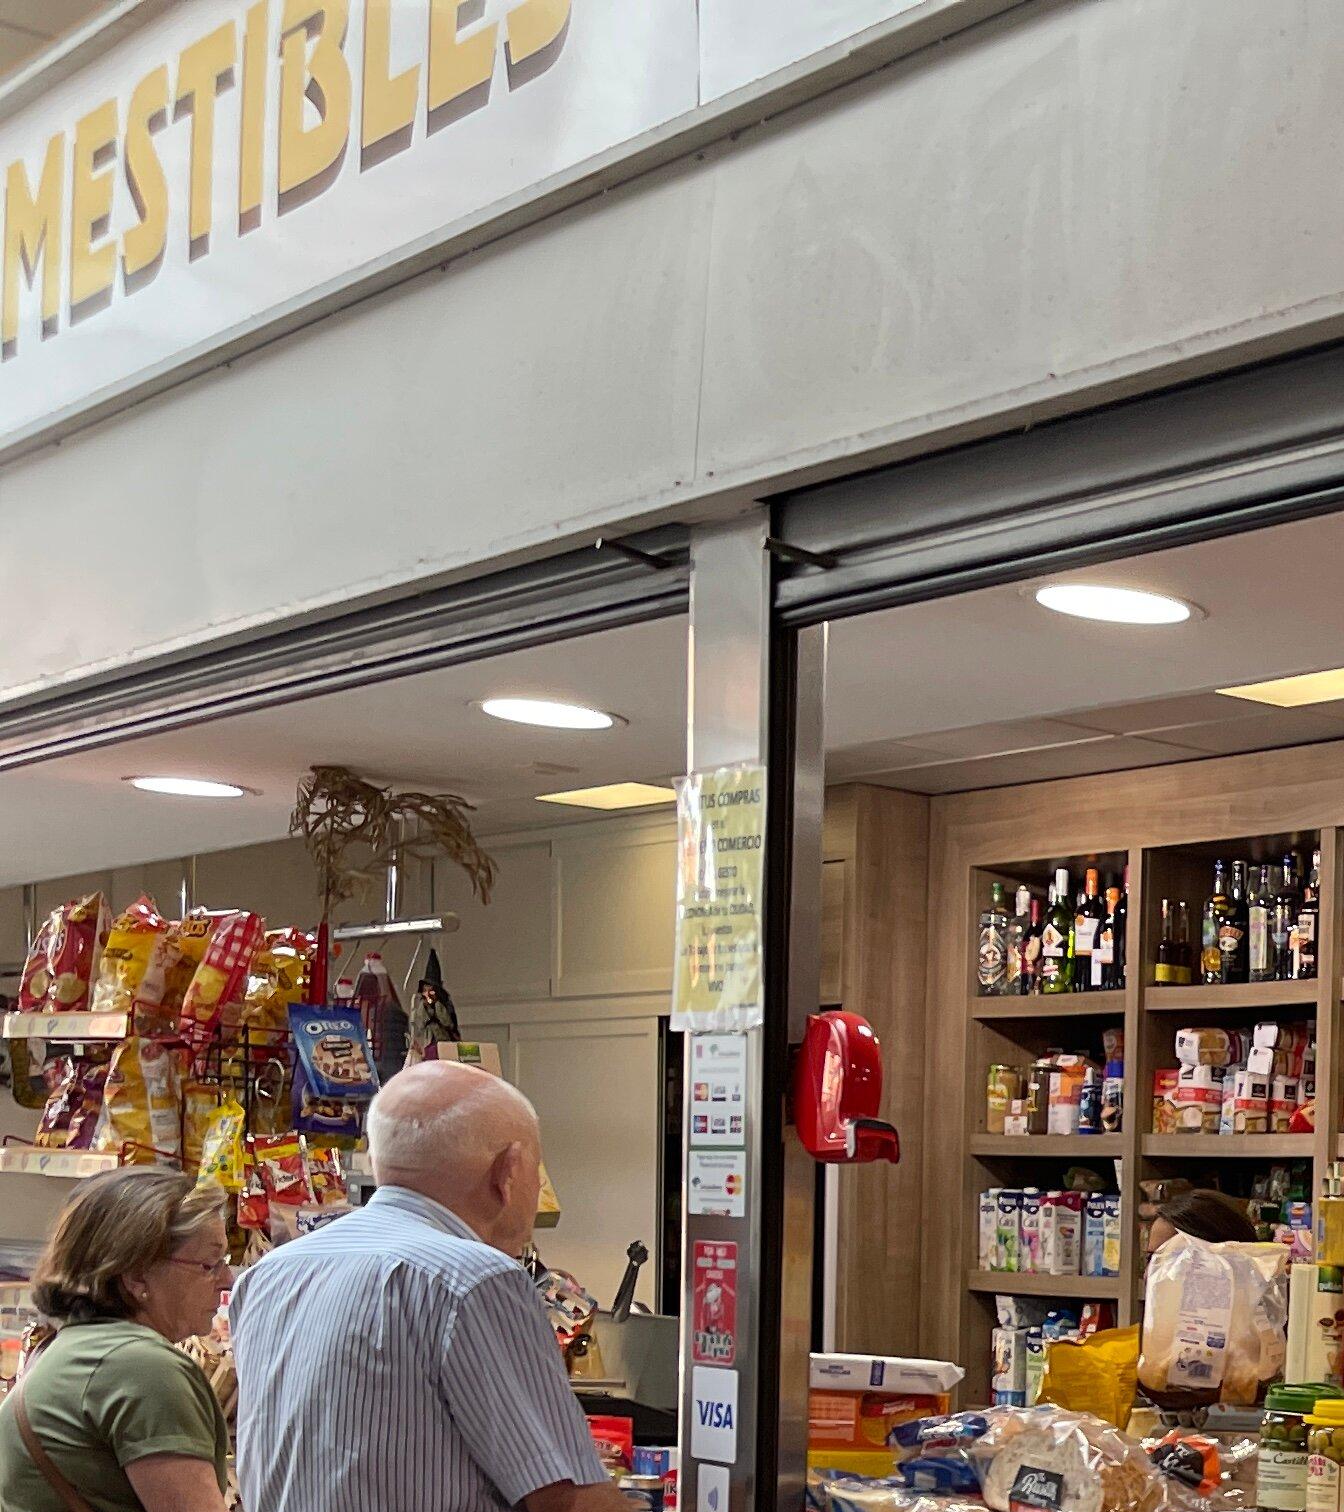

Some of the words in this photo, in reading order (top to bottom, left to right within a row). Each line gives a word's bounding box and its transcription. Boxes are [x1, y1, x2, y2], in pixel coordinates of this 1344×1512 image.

[718, 788, 761, 808] COMPRAS
[718, 835, 762, 852] COMERCIO
[302, 1020, 355, 1035] OREO
[696, 1399, 734, 1430] VISA
